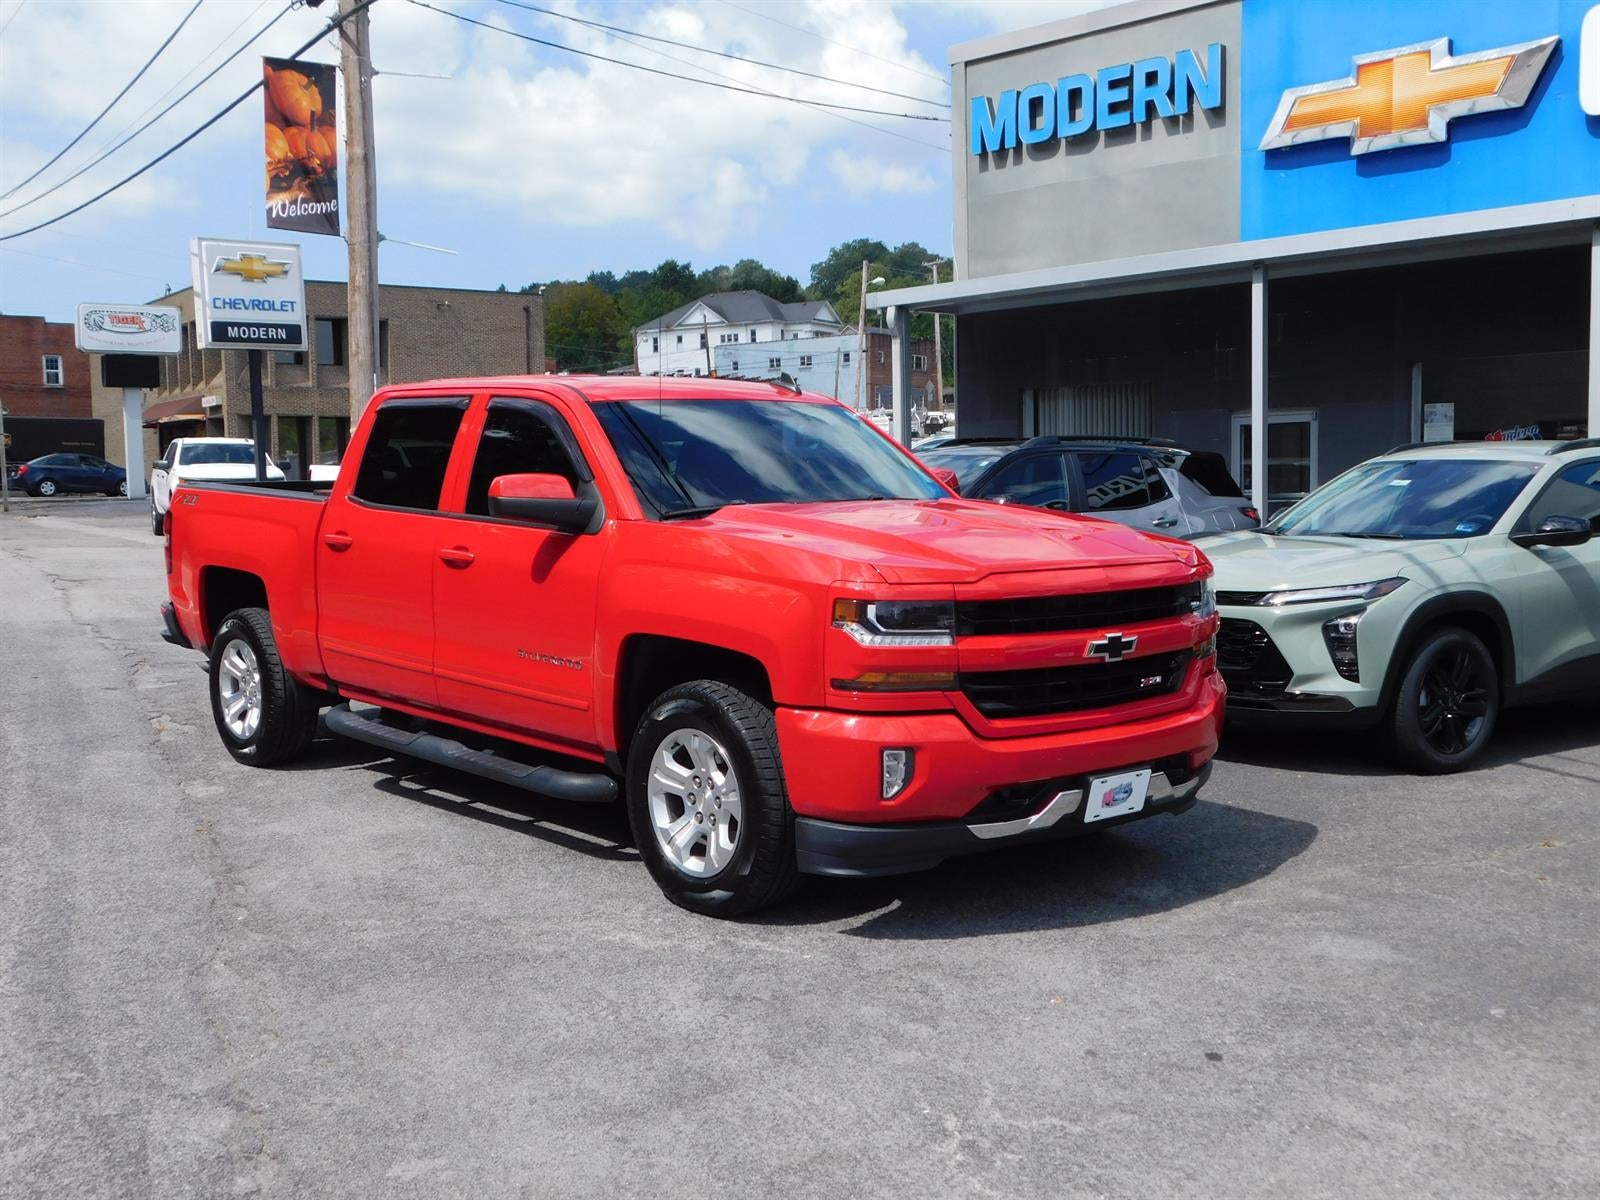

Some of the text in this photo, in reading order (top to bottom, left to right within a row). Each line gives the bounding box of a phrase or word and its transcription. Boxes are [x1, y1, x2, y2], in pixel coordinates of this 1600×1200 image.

[970, 42, 1223, 156] MODERN
[266, 192, 338, 218] Welcome
[212, 297, 297, 312] CHEVROLET
[227, 326, 287, 339] MODERN
